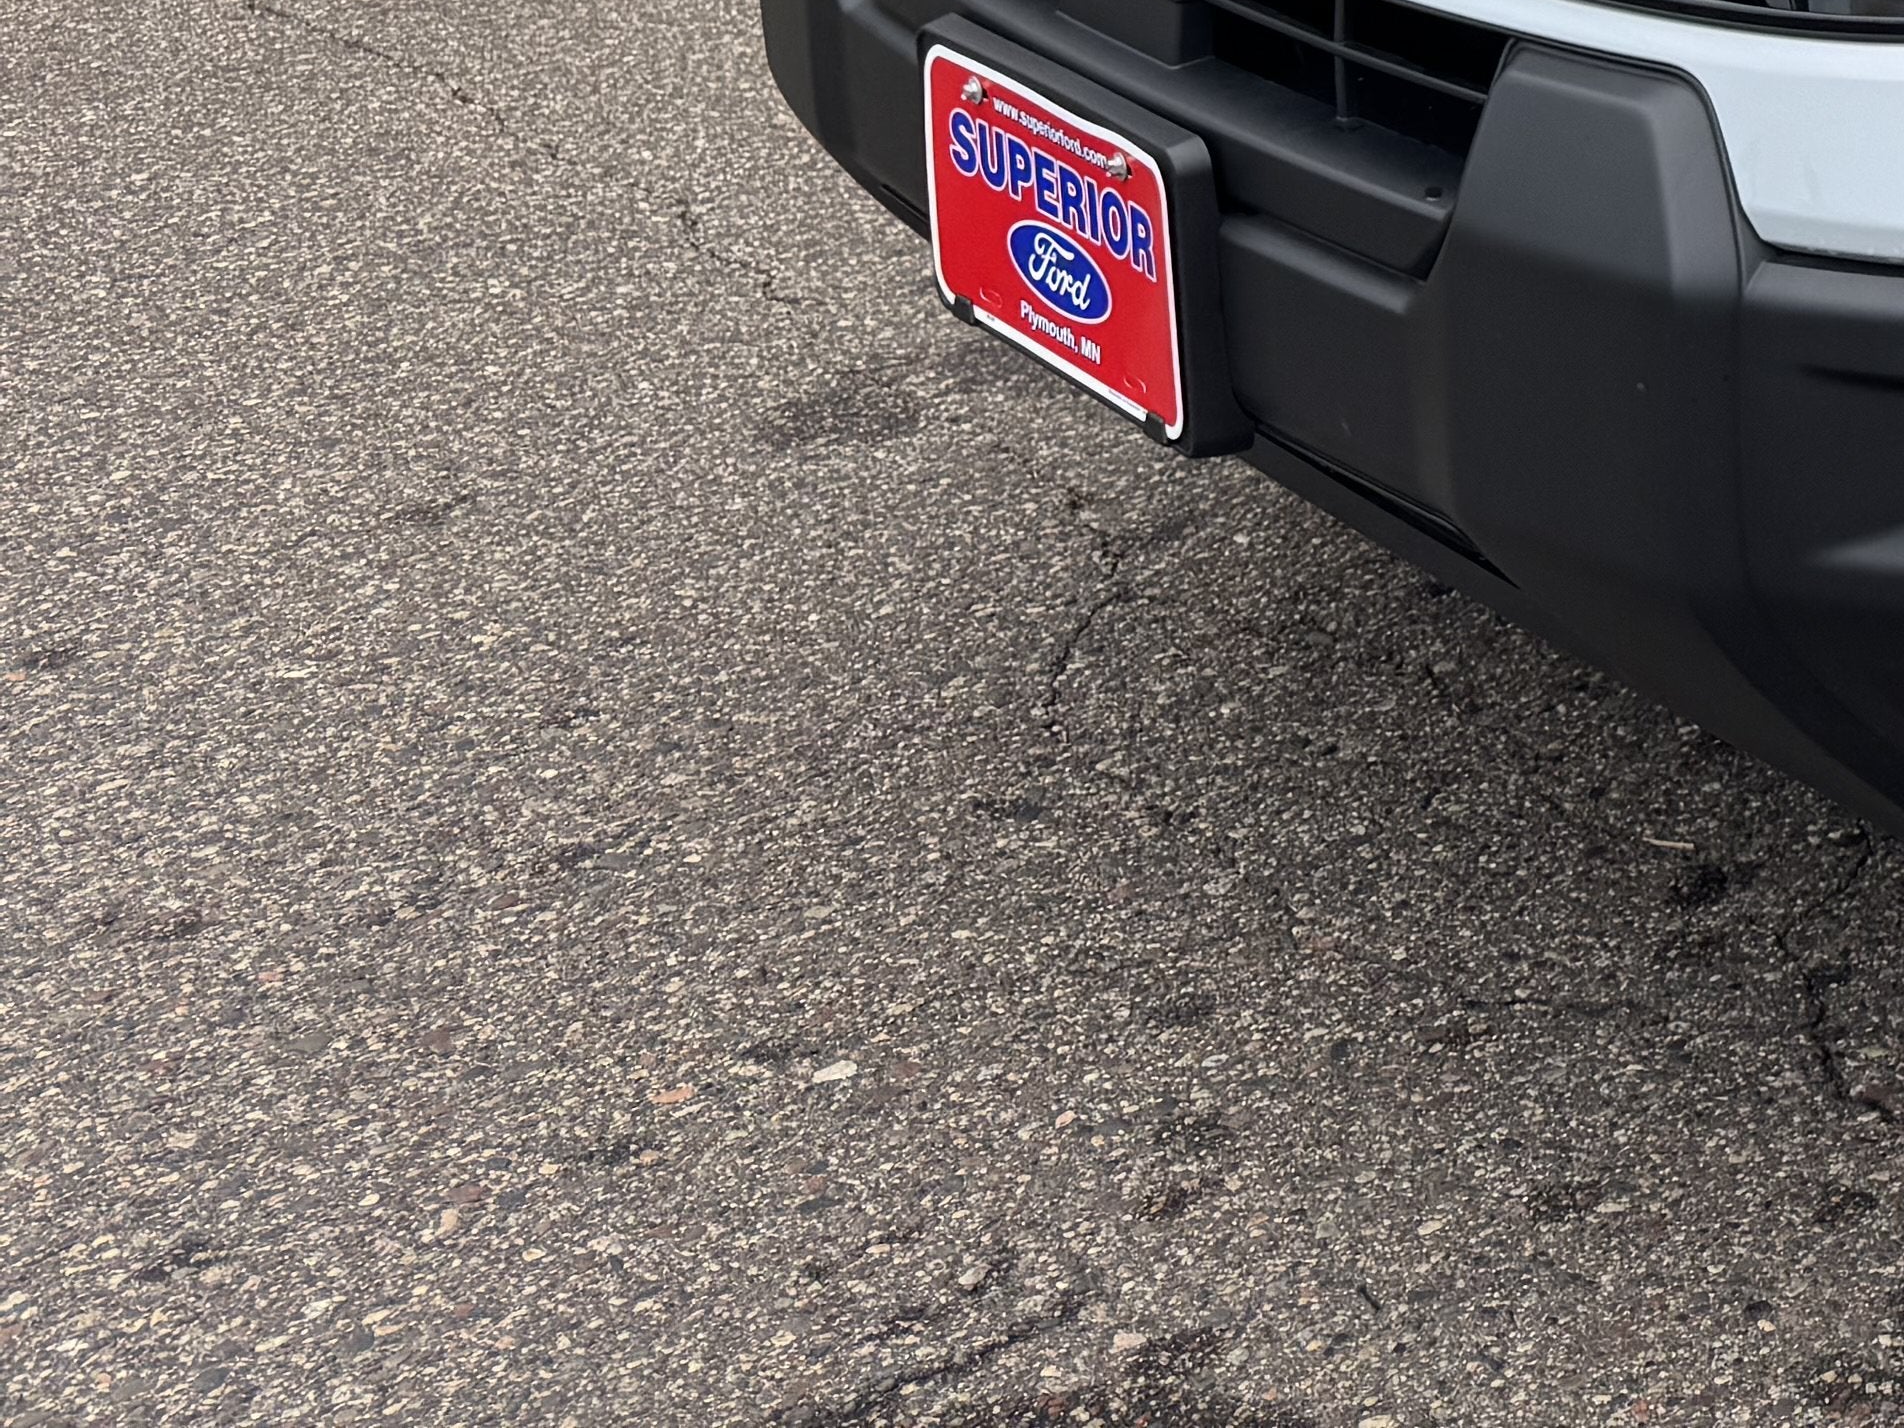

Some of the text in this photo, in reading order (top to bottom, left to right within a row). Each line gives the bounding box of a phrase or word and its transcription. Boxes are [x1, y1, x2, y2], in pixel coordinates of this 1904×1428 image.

[993, 97, 1109, 170] www.superiorford.com
[950, 107, 1158, 283] SUPERIOR
[1028, 232, 1091, 311] Ford
[1020, 299, 1101, 365] Plymouth, MN
